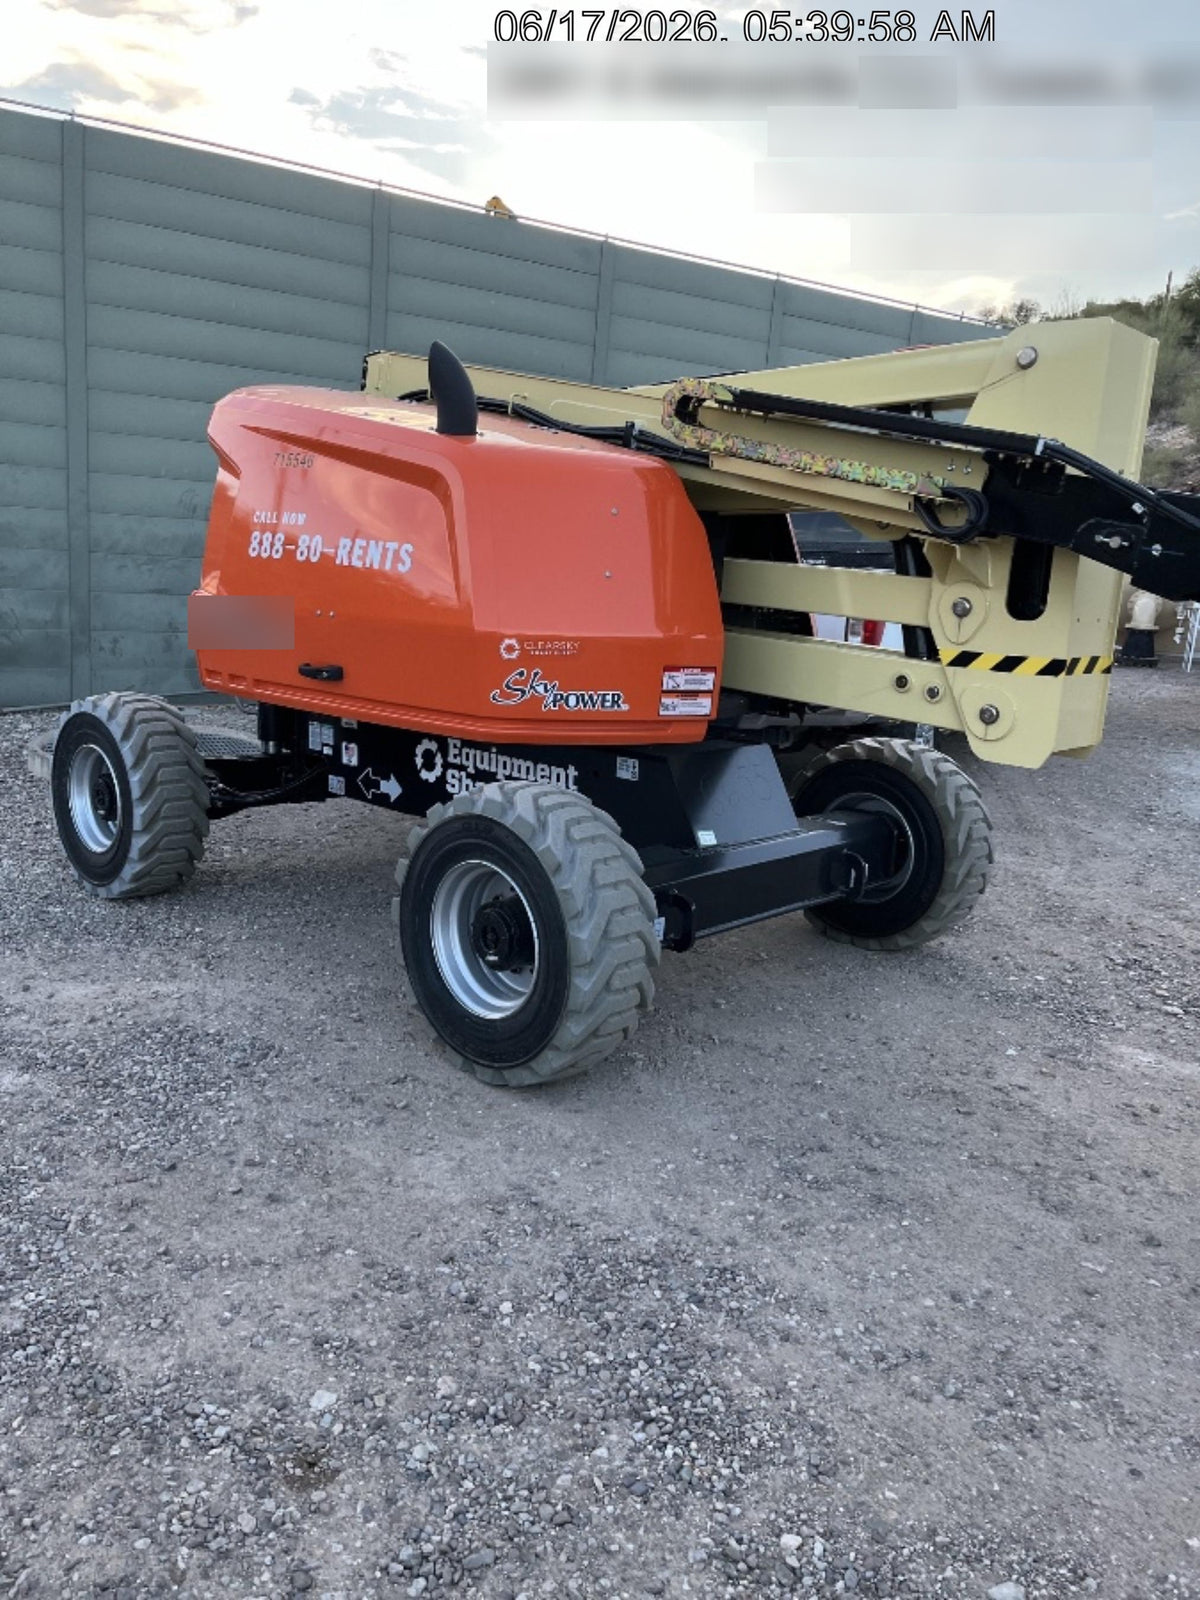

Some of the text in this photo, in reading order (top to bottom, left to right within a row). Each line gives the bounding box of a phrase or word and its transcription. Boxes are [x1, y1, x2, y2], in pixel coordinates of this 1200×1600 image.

[253, 511, 306, 525] CALL NOW
[249, 531, 413, 573] 888-80-RENTS
[490, 667, 559, 712] Sky
[549, 690, 624, 711] POWER
[447, 738, 579, 791] Equipment
